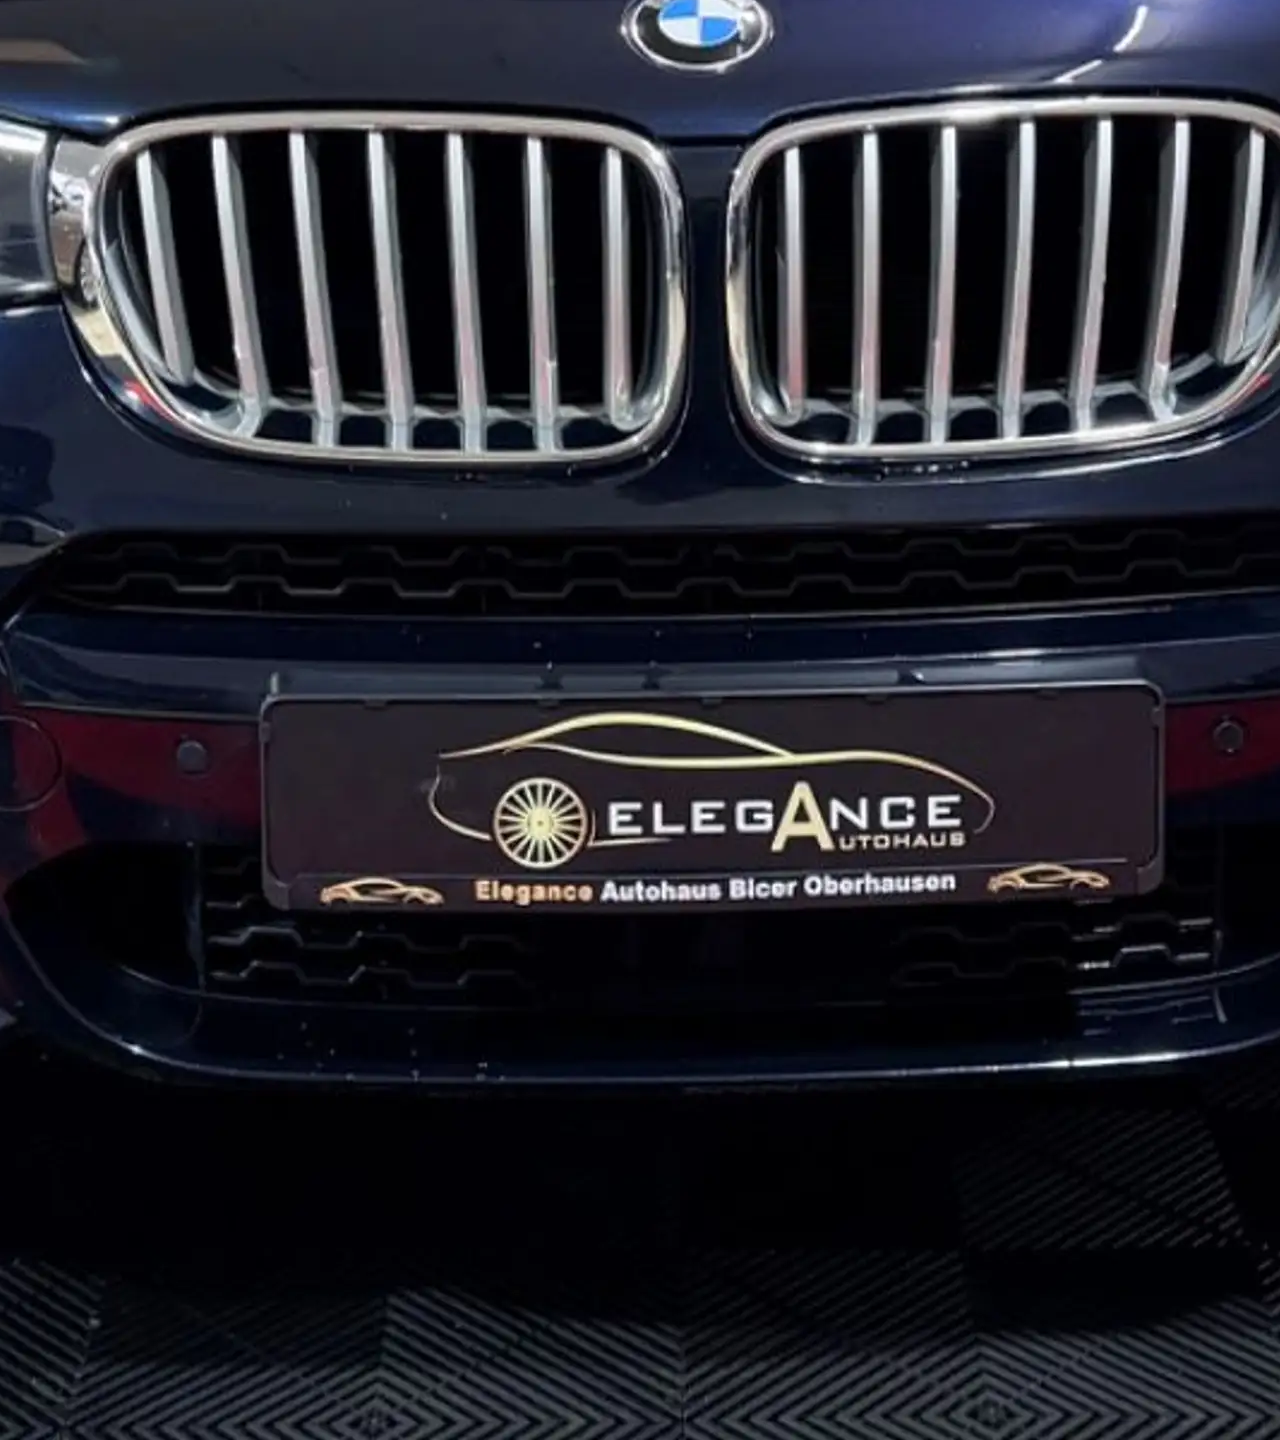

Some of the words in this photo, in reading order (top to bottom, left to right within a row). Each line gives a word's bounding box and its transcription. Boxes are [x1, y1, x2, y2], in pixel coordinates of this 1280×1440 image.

[608, 781, 961, 852] ELEGANCE
[475, 880, 593, 906] Elegance
[600, 880, 721, 902] Autohaus
[729, 877, 797, 900] Bicer
[803, 872, 956, 897] Oberhausen
